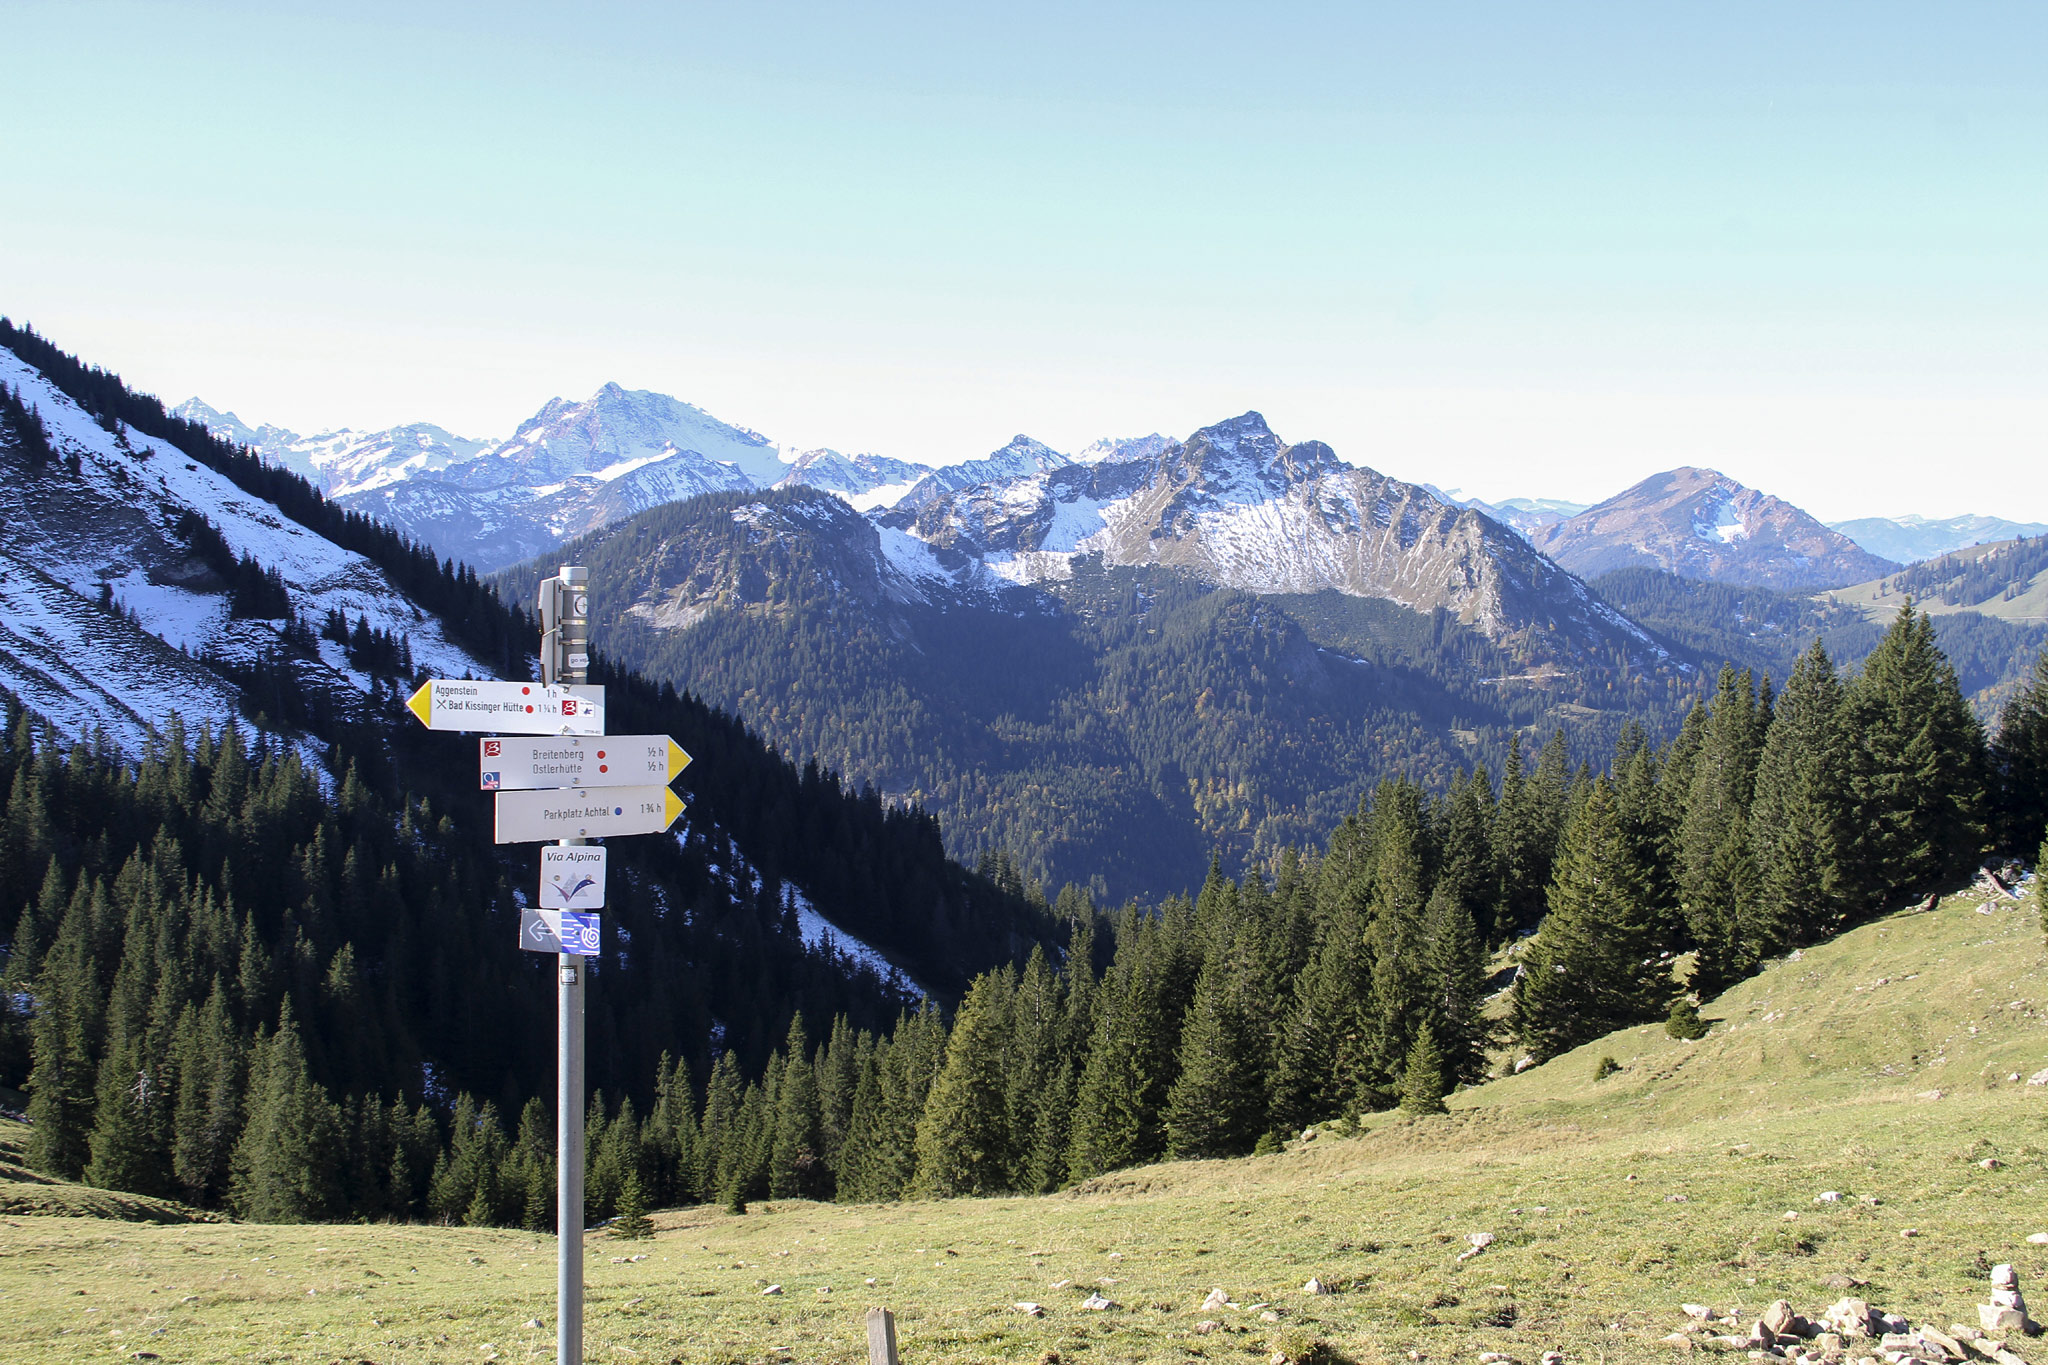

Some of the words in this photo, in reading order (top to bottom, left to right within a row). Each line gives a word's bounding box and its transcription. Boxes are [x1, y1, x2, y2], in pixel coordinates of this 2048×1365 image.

[435, 685, 478, 697] Aggenstein
[546, 689, 550, 698] 1
[552, 689, 557, 698] h
[448, 700, 463, 710] Bad
[465, 701, 501, 714] Kissinger
[503, 702, 524, 712] Hütte
[538, 704, 542, 712] 1
[552, 704, 557, 713] h
[532, 749, 584, 761] Breitenberg
[658, 747, 664, 756] h
[658, 761, 664, 771] h
[544, 809, 582, 820] Parkplatz
[584, 806, 610, 818] Achtal
[640, 804, 644, 814] 1
[656, 803, 662, 812] h
[546, 852, 563, 862] Via
[565, 852, 601, 864] Alpina
